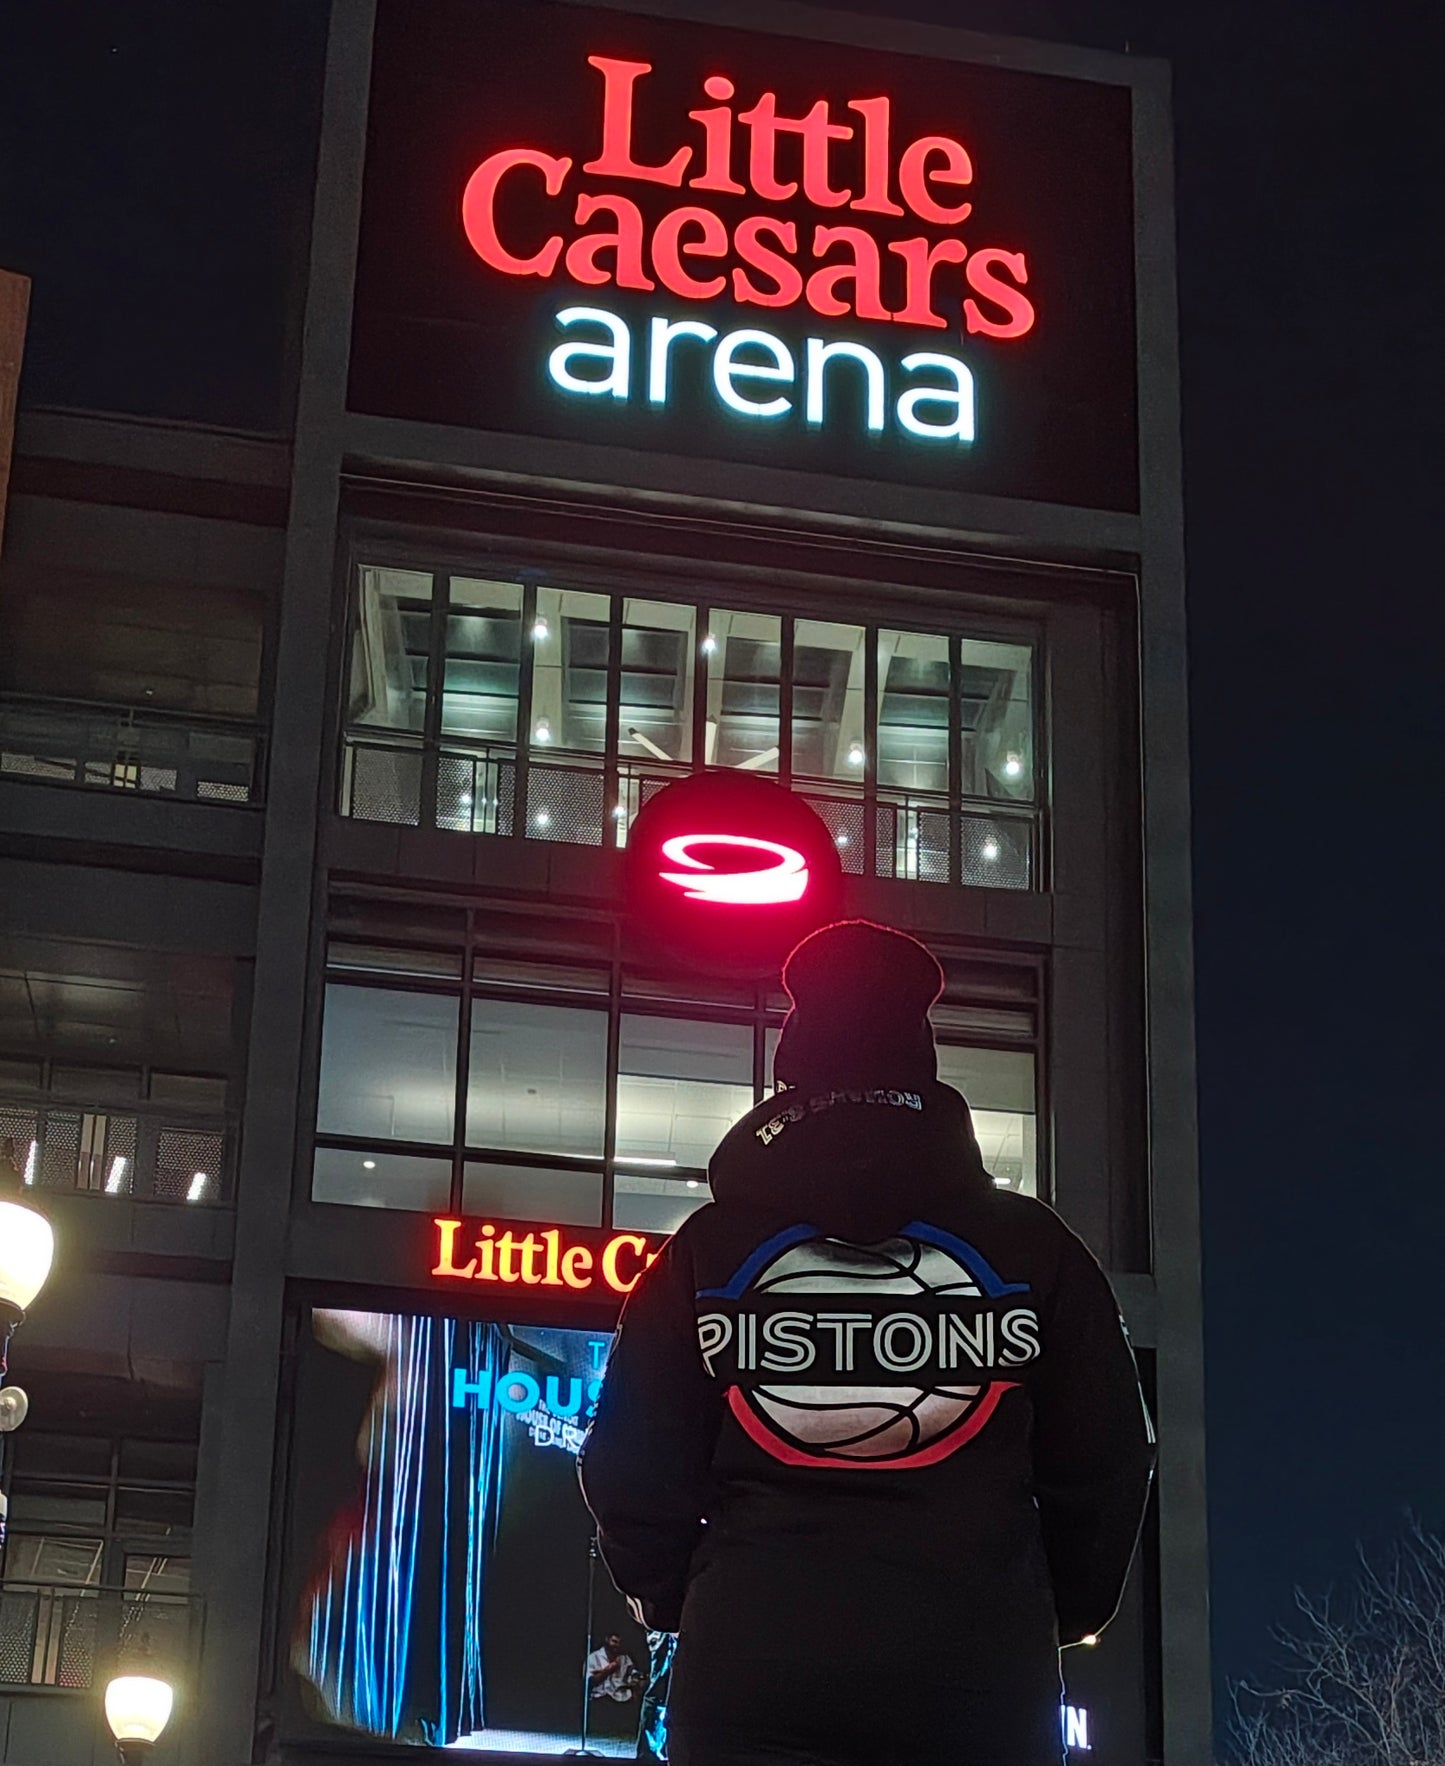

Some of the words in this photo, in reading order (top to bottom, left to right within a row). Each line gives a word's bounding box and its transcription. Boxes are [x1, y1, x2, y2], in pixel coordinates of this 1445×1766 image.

[583, 55, 973, 225] Little
[462, 148, 1035, 339] Caesars
[547, 306, 975, 442] arena
[432, 1218, 592, 1289] Little
[602, 1234, 658, 1292] C
[697, 1308, 1040, 1378] PISTONS
[1061, 1704, 1092, 1750] N.
